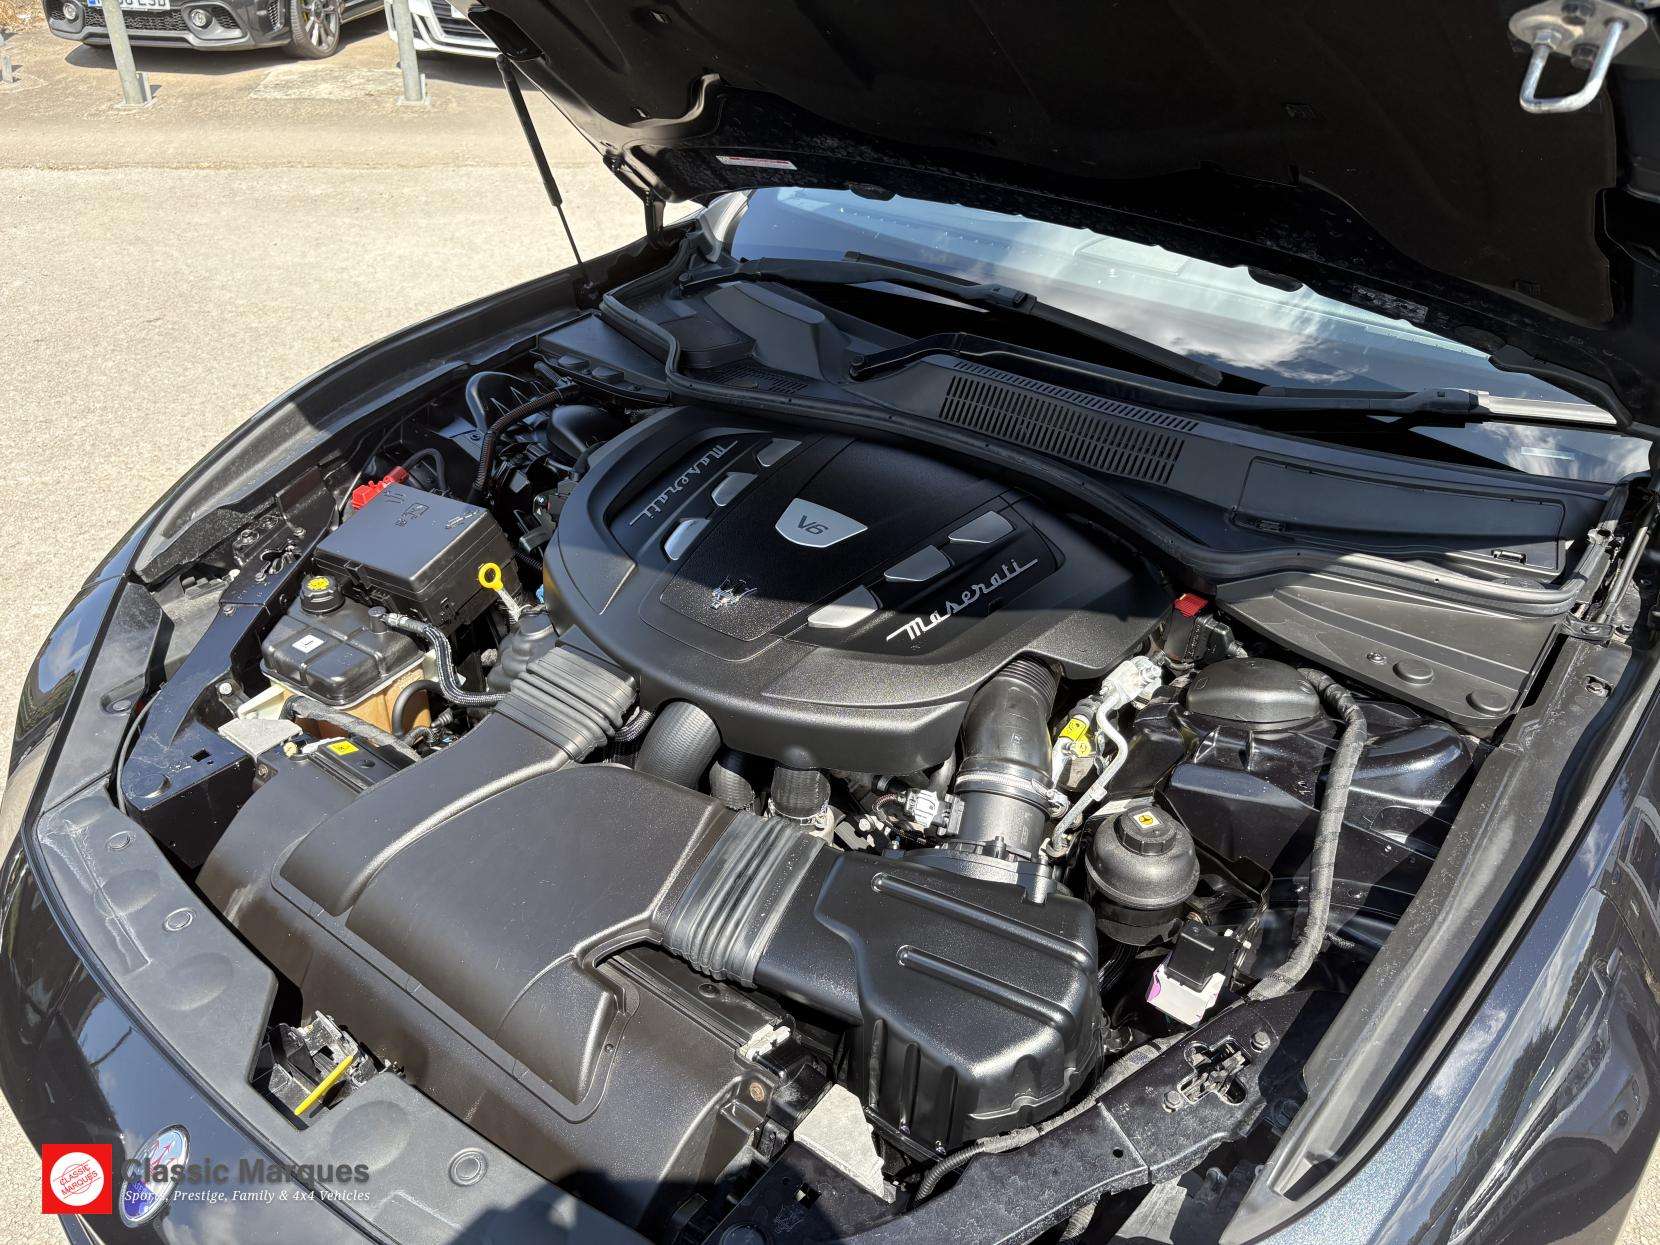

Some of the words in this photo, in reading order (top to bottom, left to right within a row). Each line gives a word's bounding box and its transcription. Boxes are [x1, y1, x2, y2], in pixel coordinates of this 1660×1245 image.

[630, 441, 738, 526] Maserati
[798, 515, 829, 535] V6
[887, 559, 1038, 641] Maserati
